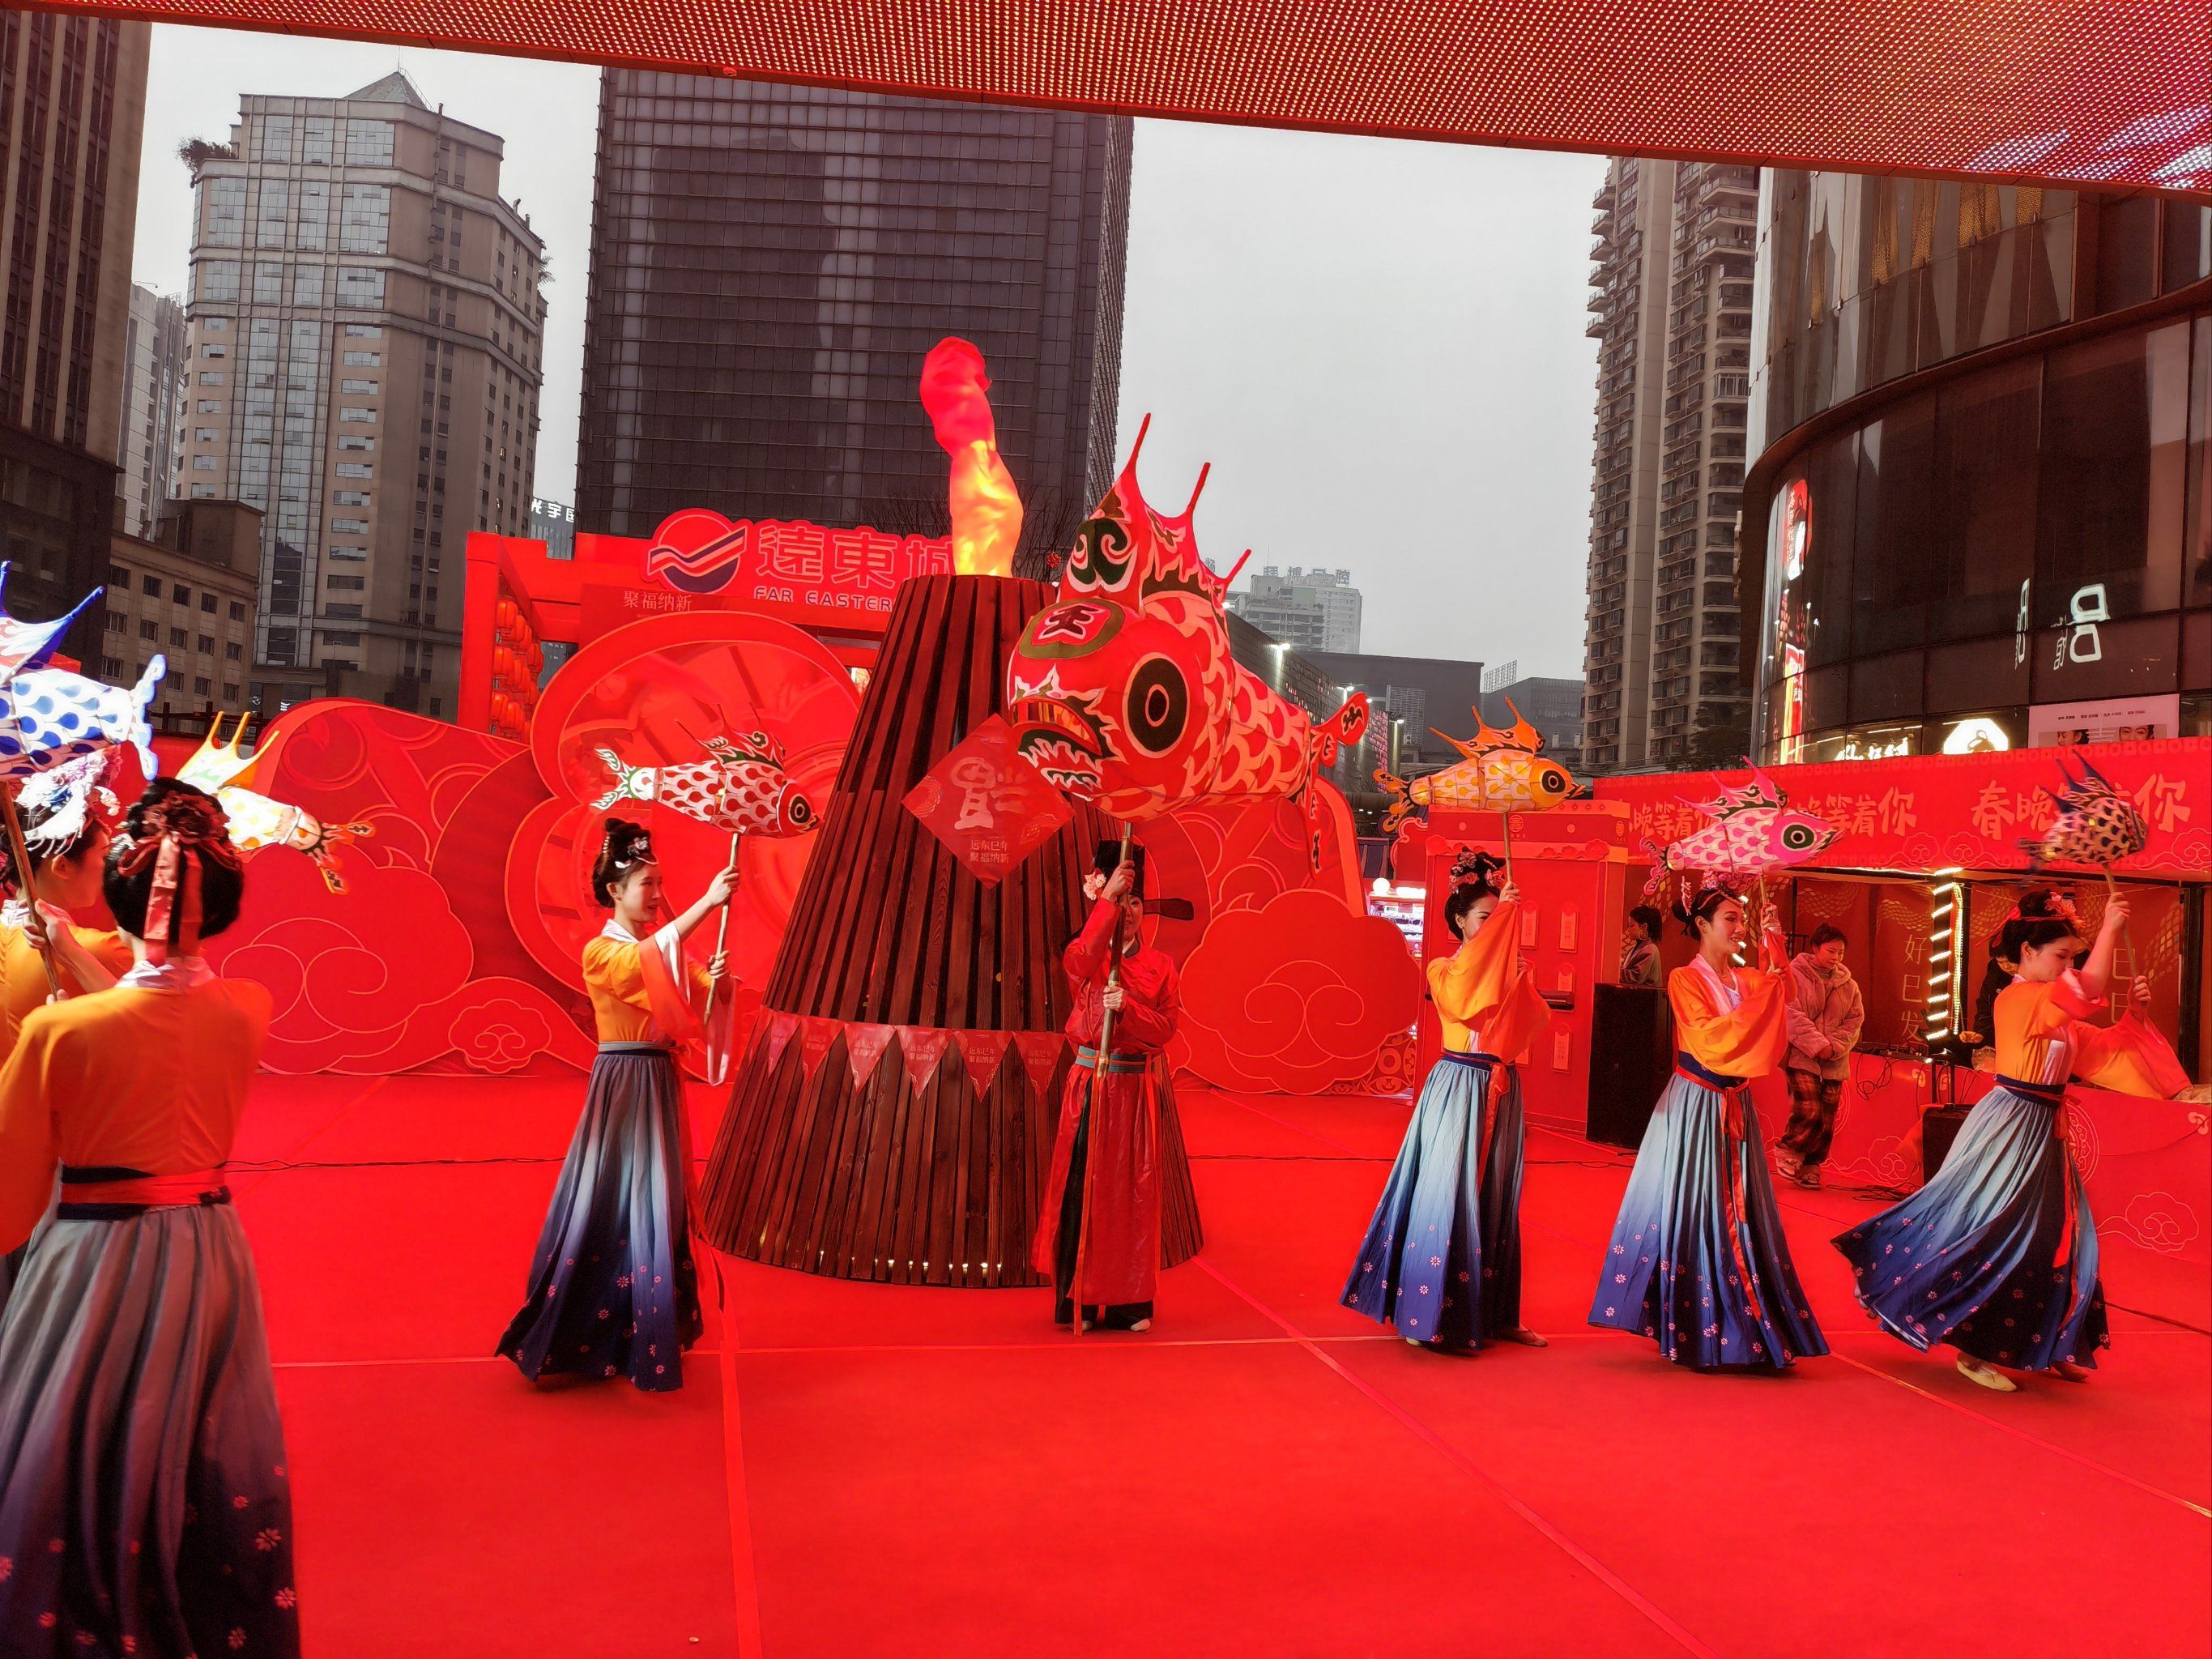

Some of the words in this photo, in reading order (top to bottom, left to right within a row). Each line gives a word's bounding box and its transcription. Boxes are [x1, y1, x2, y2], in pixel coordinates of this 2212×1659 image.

[623, 591, 693, 612] 聚福纳新
[754, 585, 793, 603] FAR
[1971, 773, 2191, 841] 春晚你
[970, 840, 1008, 851] 远东巳年
[970, 852, 1009, 864] 聚福纳新
